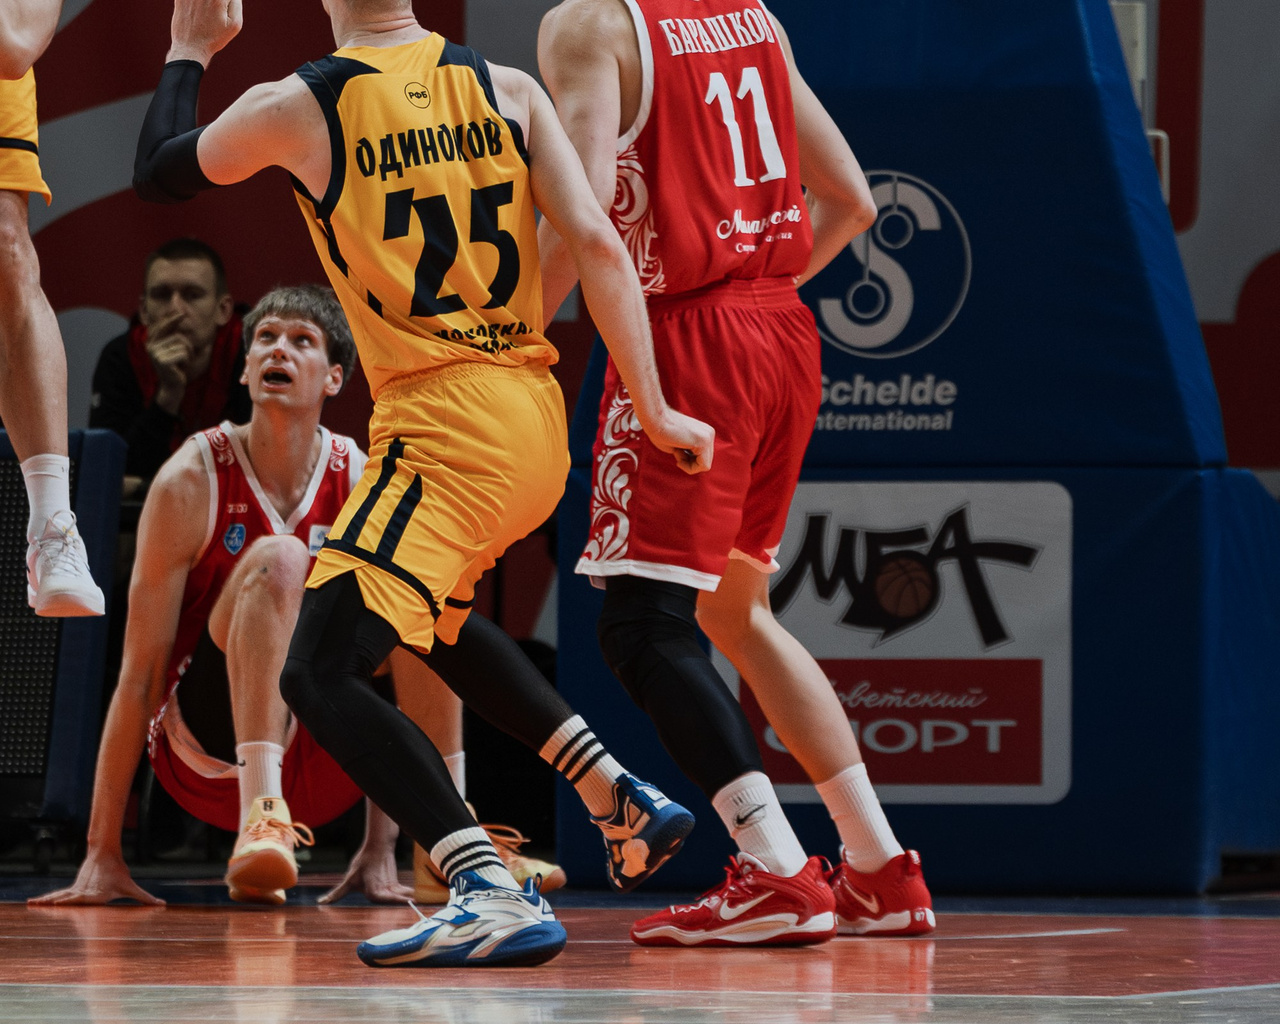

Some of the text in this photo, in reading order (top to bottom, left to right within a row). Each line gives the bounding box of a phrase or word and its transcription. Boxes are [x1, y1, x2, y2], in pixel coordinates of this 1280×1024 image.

[355, 118, 503, 181] ОДИНОКОВ
[705, 67, 787, 187] 11
[383, 180, 521, 318] 25
